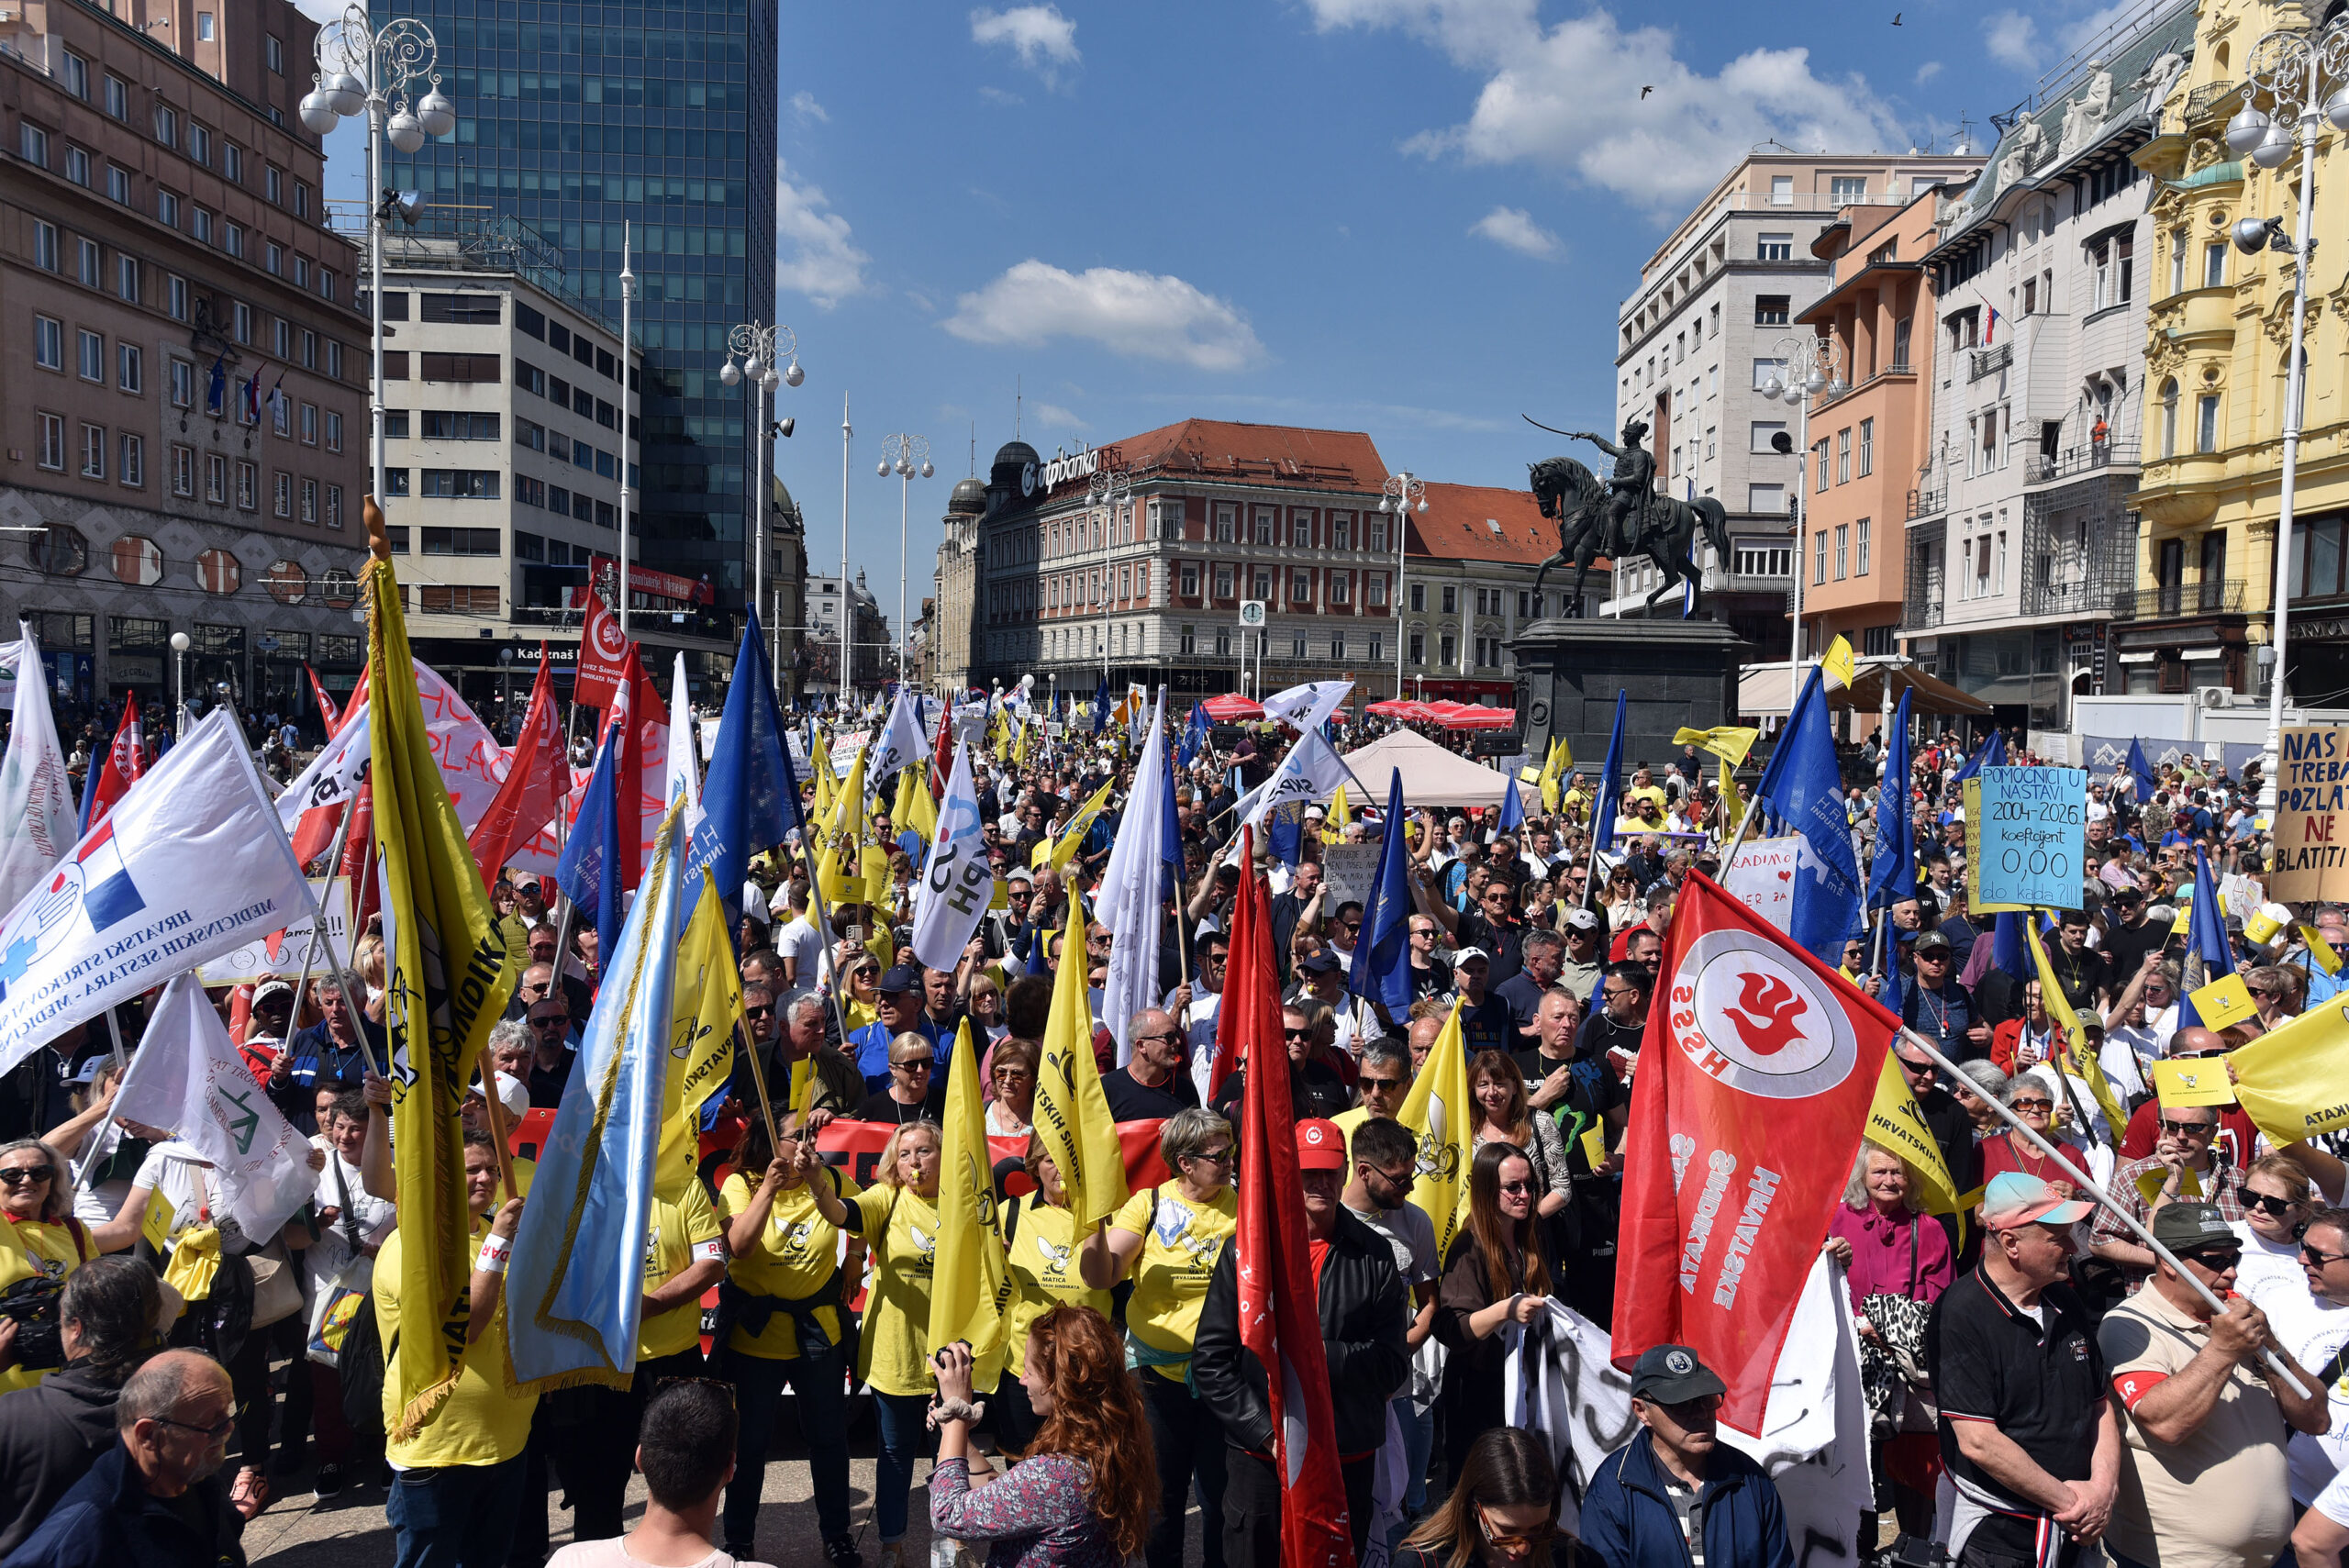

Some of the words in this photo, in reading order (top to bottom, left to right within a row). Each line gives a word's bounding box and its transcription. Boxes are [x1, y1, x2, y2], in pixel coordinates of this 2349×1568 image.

[518, 648, 543, 660] Kad
[548, 647, 573, 660] znaš
[580, 672, 605, 683] INDIKATA
[582, 664, 597, 673] AVEZ
[2284, 731, 2336, 761] NAS
[2068, 771, 2080, 788] U
[28, 780, 48, 806] UNION
[2000, 784, 2064, 802] NASTAVI
[2277, 784, 2349, 814] POZLA
[27, 806, 42, 817] OF
[28, 818, 57, 858] CROATIA
[2305, 815, 2335, 842] NE
[1731, 853, 1791, 868] RADIMO
[2001, 848, 2068, 883] 0,00
[2276, 846, 2347, 873] BLATITI
[1328, 883, 1341, 893] EŠKA
[1982, 881, 2007, 900] do
[2017, 883, 2054, 903] kada
[1034, 1077, 1066, 1130] ATSKIH
[1872, 1114, 1936, 1164] HRVATSKIH
[1593, 1247, 1614, 1257] PUMA
